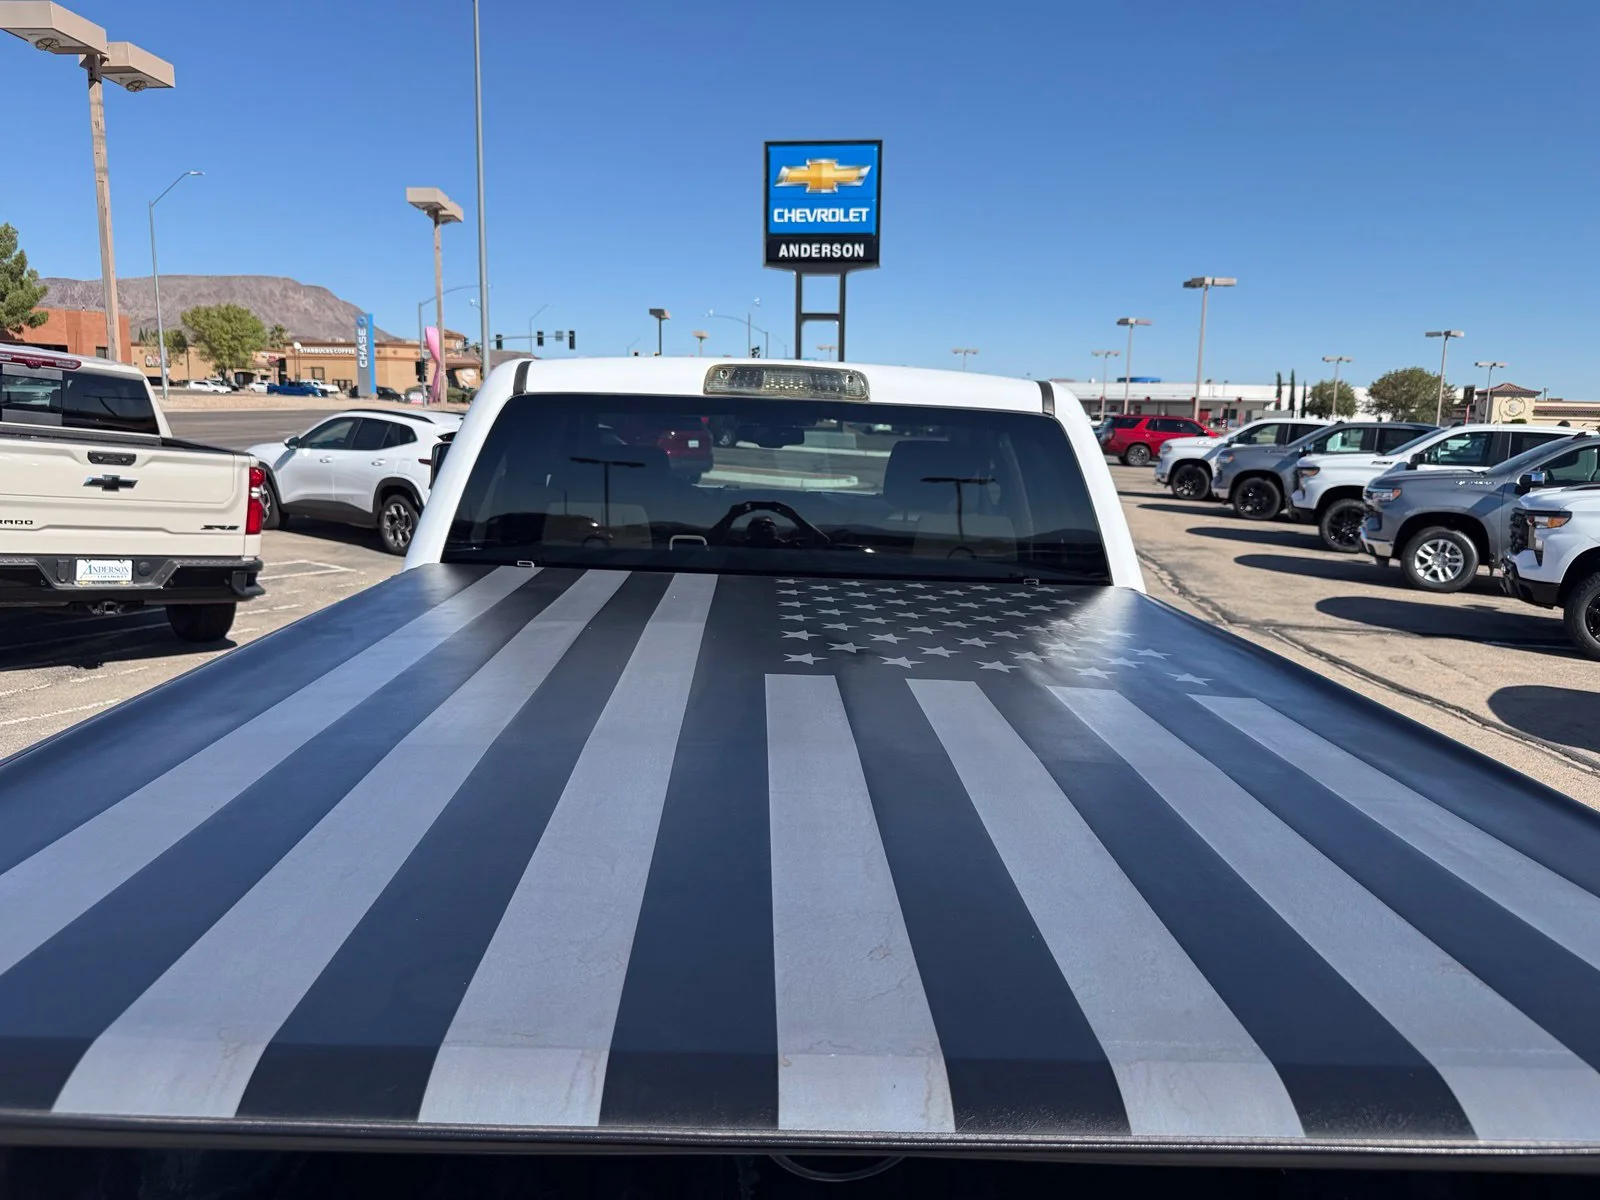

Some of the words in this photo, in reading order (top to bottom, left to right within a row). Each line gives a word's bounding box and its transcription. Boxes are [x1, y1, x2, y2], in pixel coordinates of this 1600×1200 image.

[773, 208, 870, 222] CHEVROLET
[778, 243, 865, 258] ANDERSON
[358, 328, 368, 368] CHASE
[80, 564, 129, 578] ANDERSON
